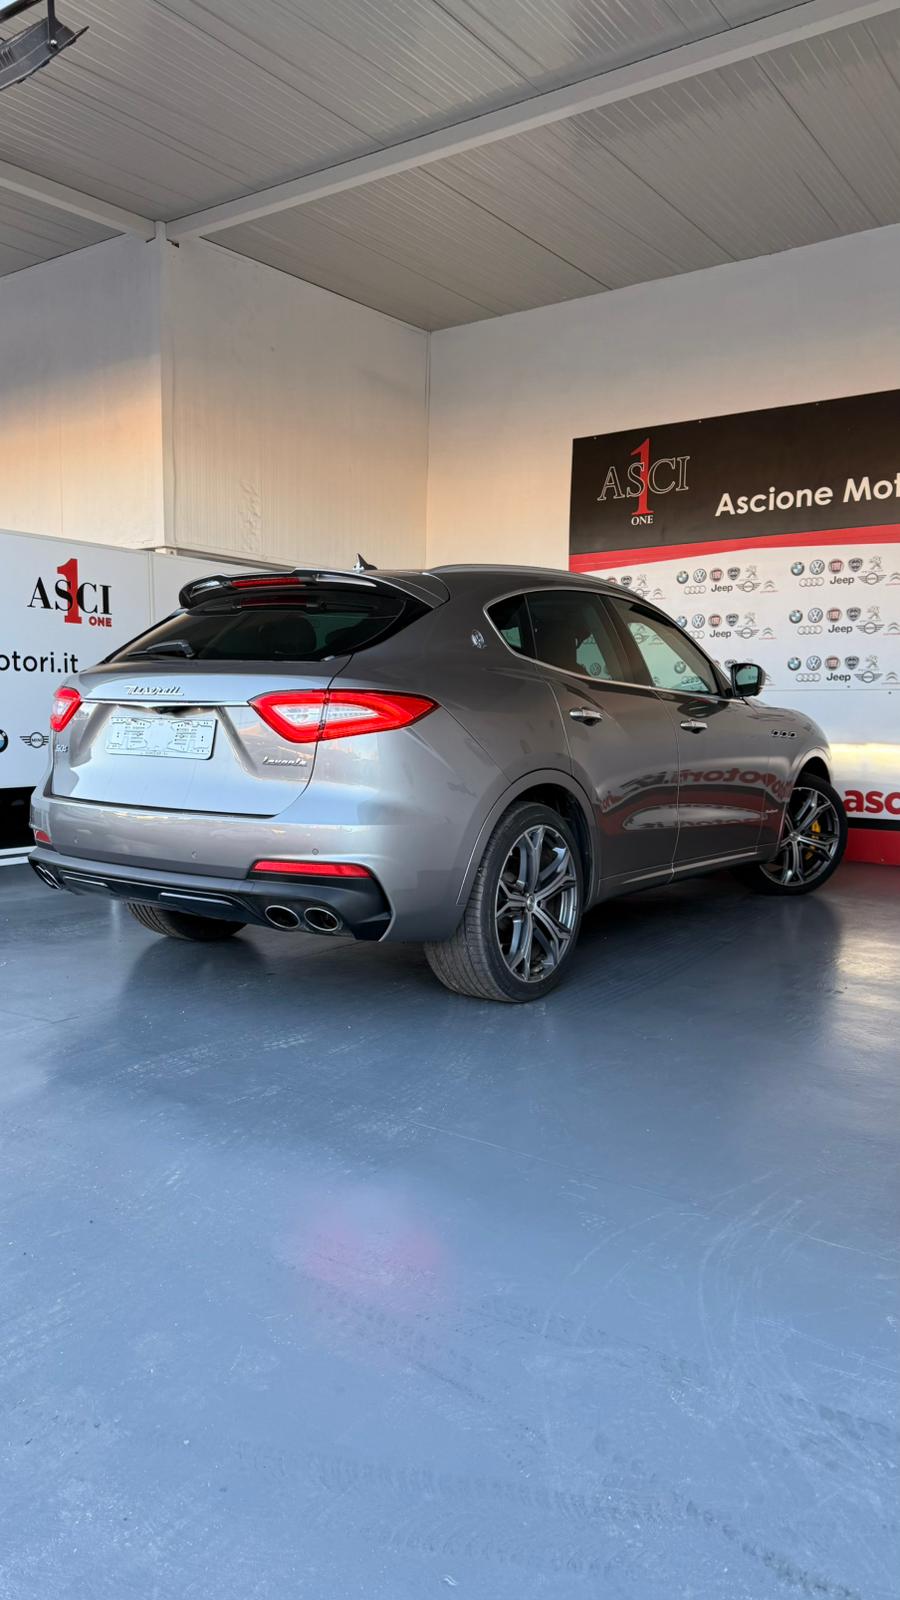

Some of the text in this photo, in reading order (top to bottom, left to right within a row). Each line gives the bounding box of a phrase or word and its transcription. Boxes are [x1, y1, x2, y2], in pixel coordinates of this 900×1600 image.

[597, 456, 690, 501] ASCI
[715, 486, 833, 517] Ascione
[631, 515, 654, 526] ONE
[829, 575, 855, 586] Jeep
[711, 584, 733, 593] Jeep
[27, 576, 113, 615] ASCI
[88, 615, 113, 627] ONE
[709, 630, 732, 639] Jeep
[828, 624, 853, 634] Jeep
[0, 651, 79, 674] otori.it
[826, 673, 852, 683] Jeep
[843, 790, 900, 815] asc
